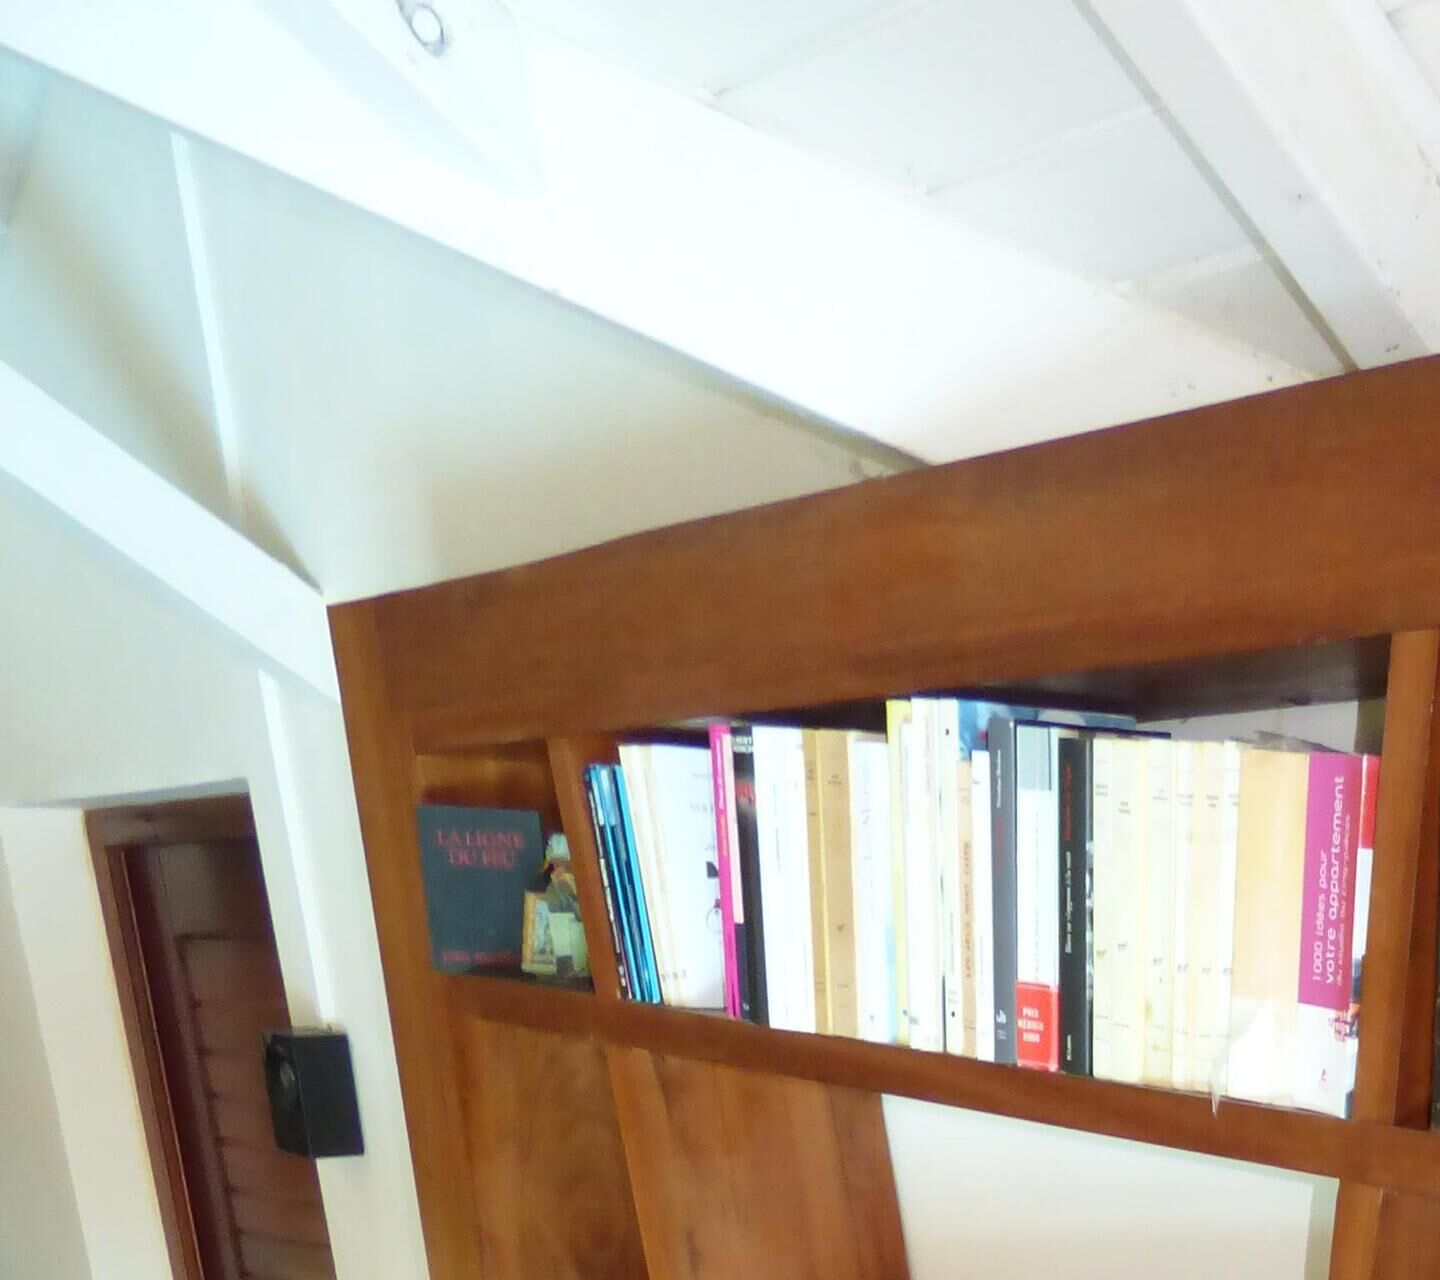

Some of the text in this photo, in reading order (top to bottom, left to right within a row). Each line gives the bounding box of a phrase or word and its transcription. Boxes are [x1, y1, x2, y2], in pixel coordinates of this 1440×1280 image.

[437, 829, 525, 849] LA LIGNE
[449, 849, 515, 870] DU FEU
[1313, 850, 1330, 982] 1000 idées pour
[1325, 776, 1345, 984] votre appartement
